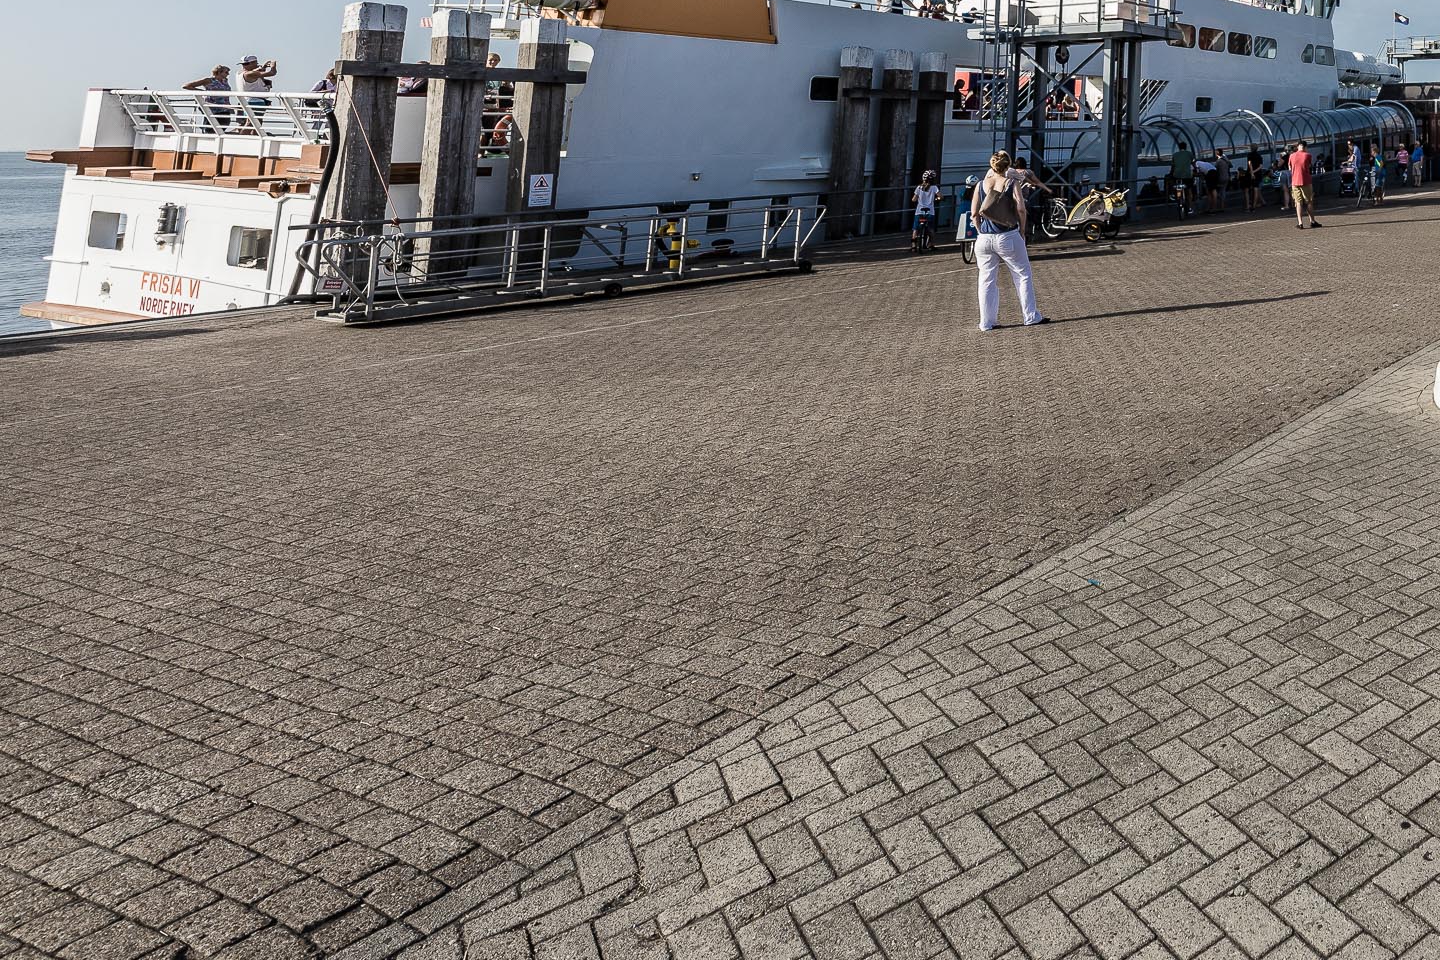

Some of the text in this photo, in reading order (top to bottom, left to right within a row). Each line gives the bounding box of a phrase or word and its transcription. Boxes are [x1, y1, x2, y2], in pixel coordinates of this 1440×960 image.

[140, 271, 201, 299] FRISIA VI
[139, 295, 195, 316] NORDERNEY
